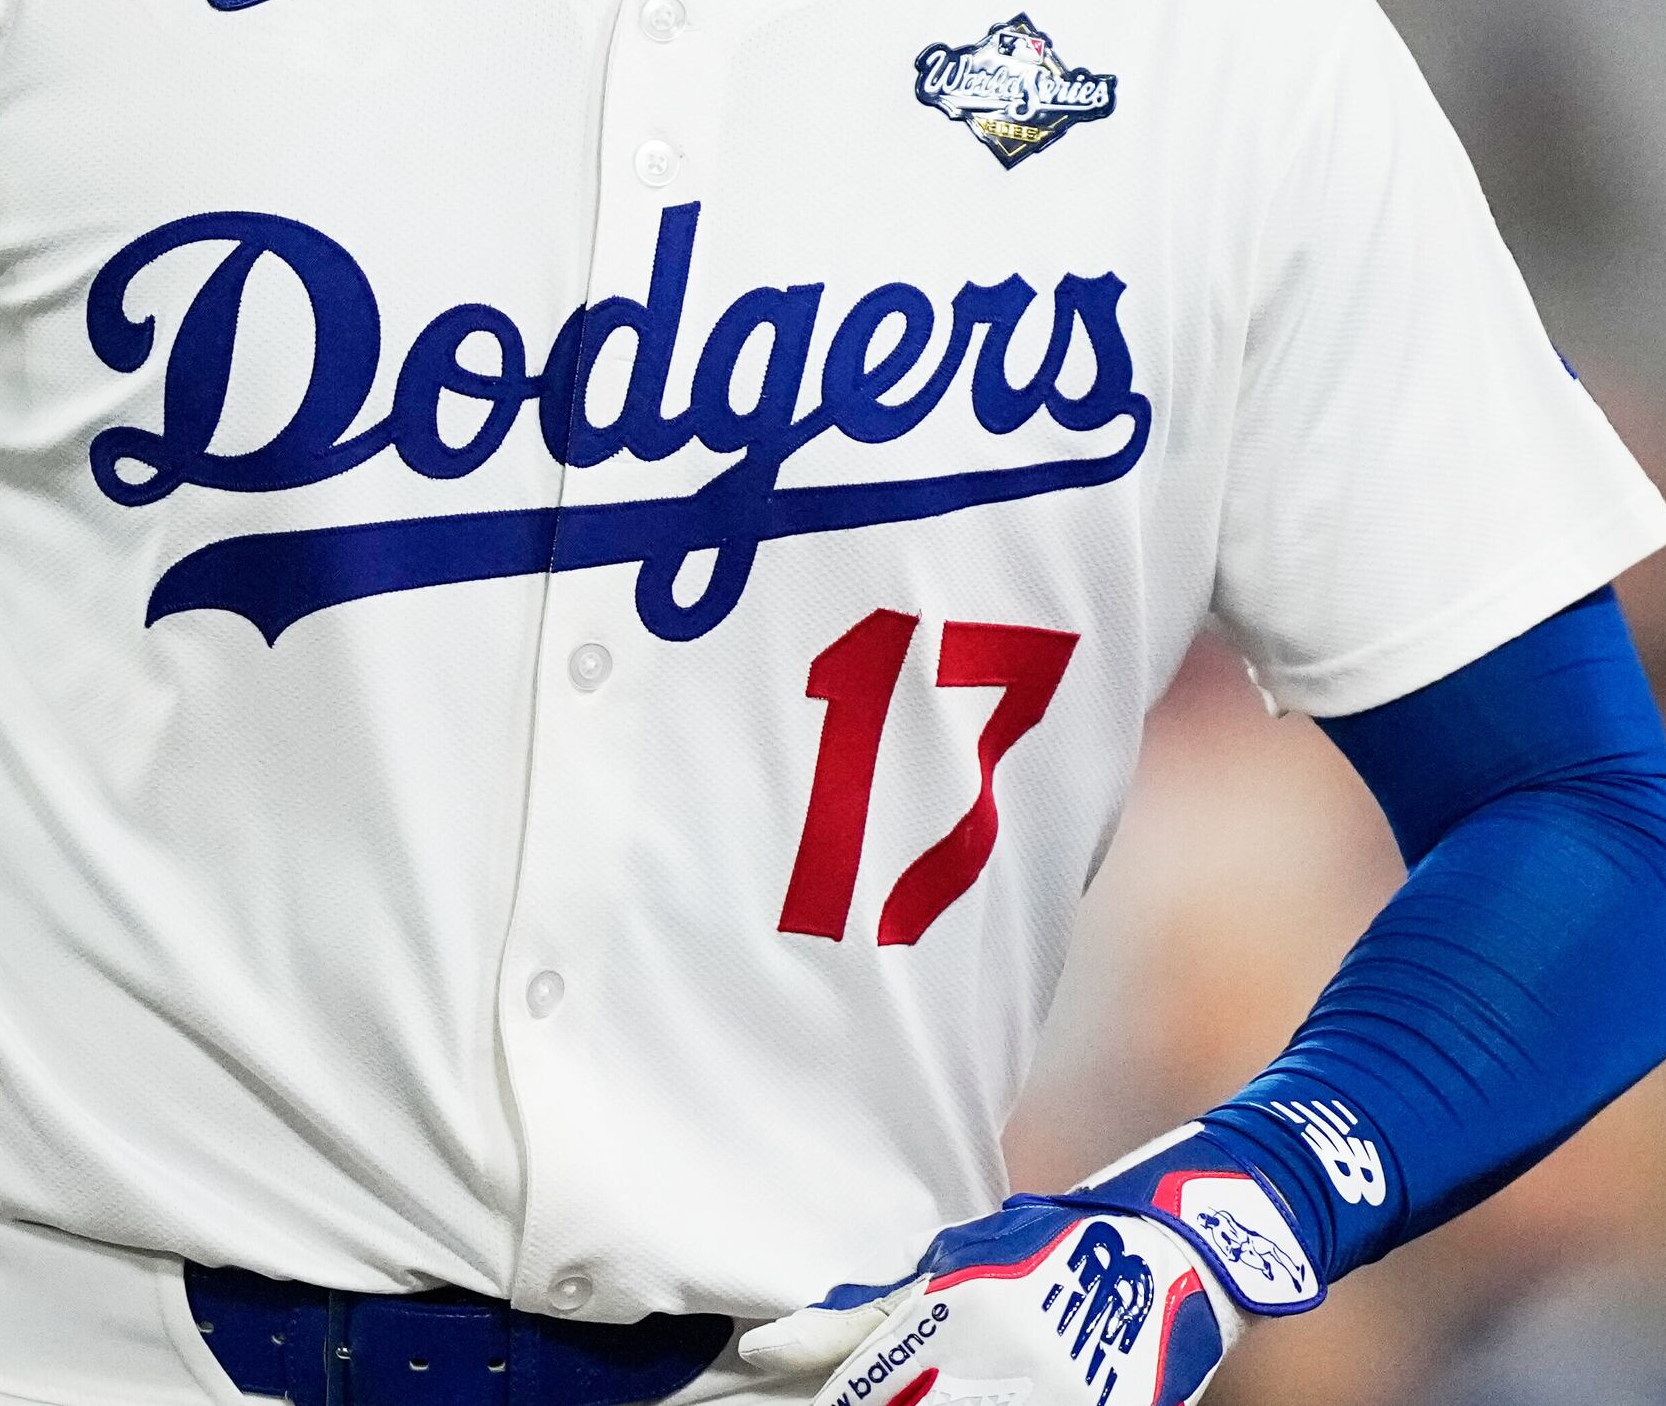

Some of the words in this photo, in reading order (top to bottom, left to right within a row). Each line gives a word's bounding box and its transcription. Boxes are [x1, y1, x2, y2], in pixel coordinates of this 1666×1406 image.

[924, 49, 1025, 100] World
[1006, 68, 1110, 122] Series
[88, 201, 1153, 642] Dodgers
[777, 608, 1080, 947] 17
[847, 1302, 950, 1400] balance
